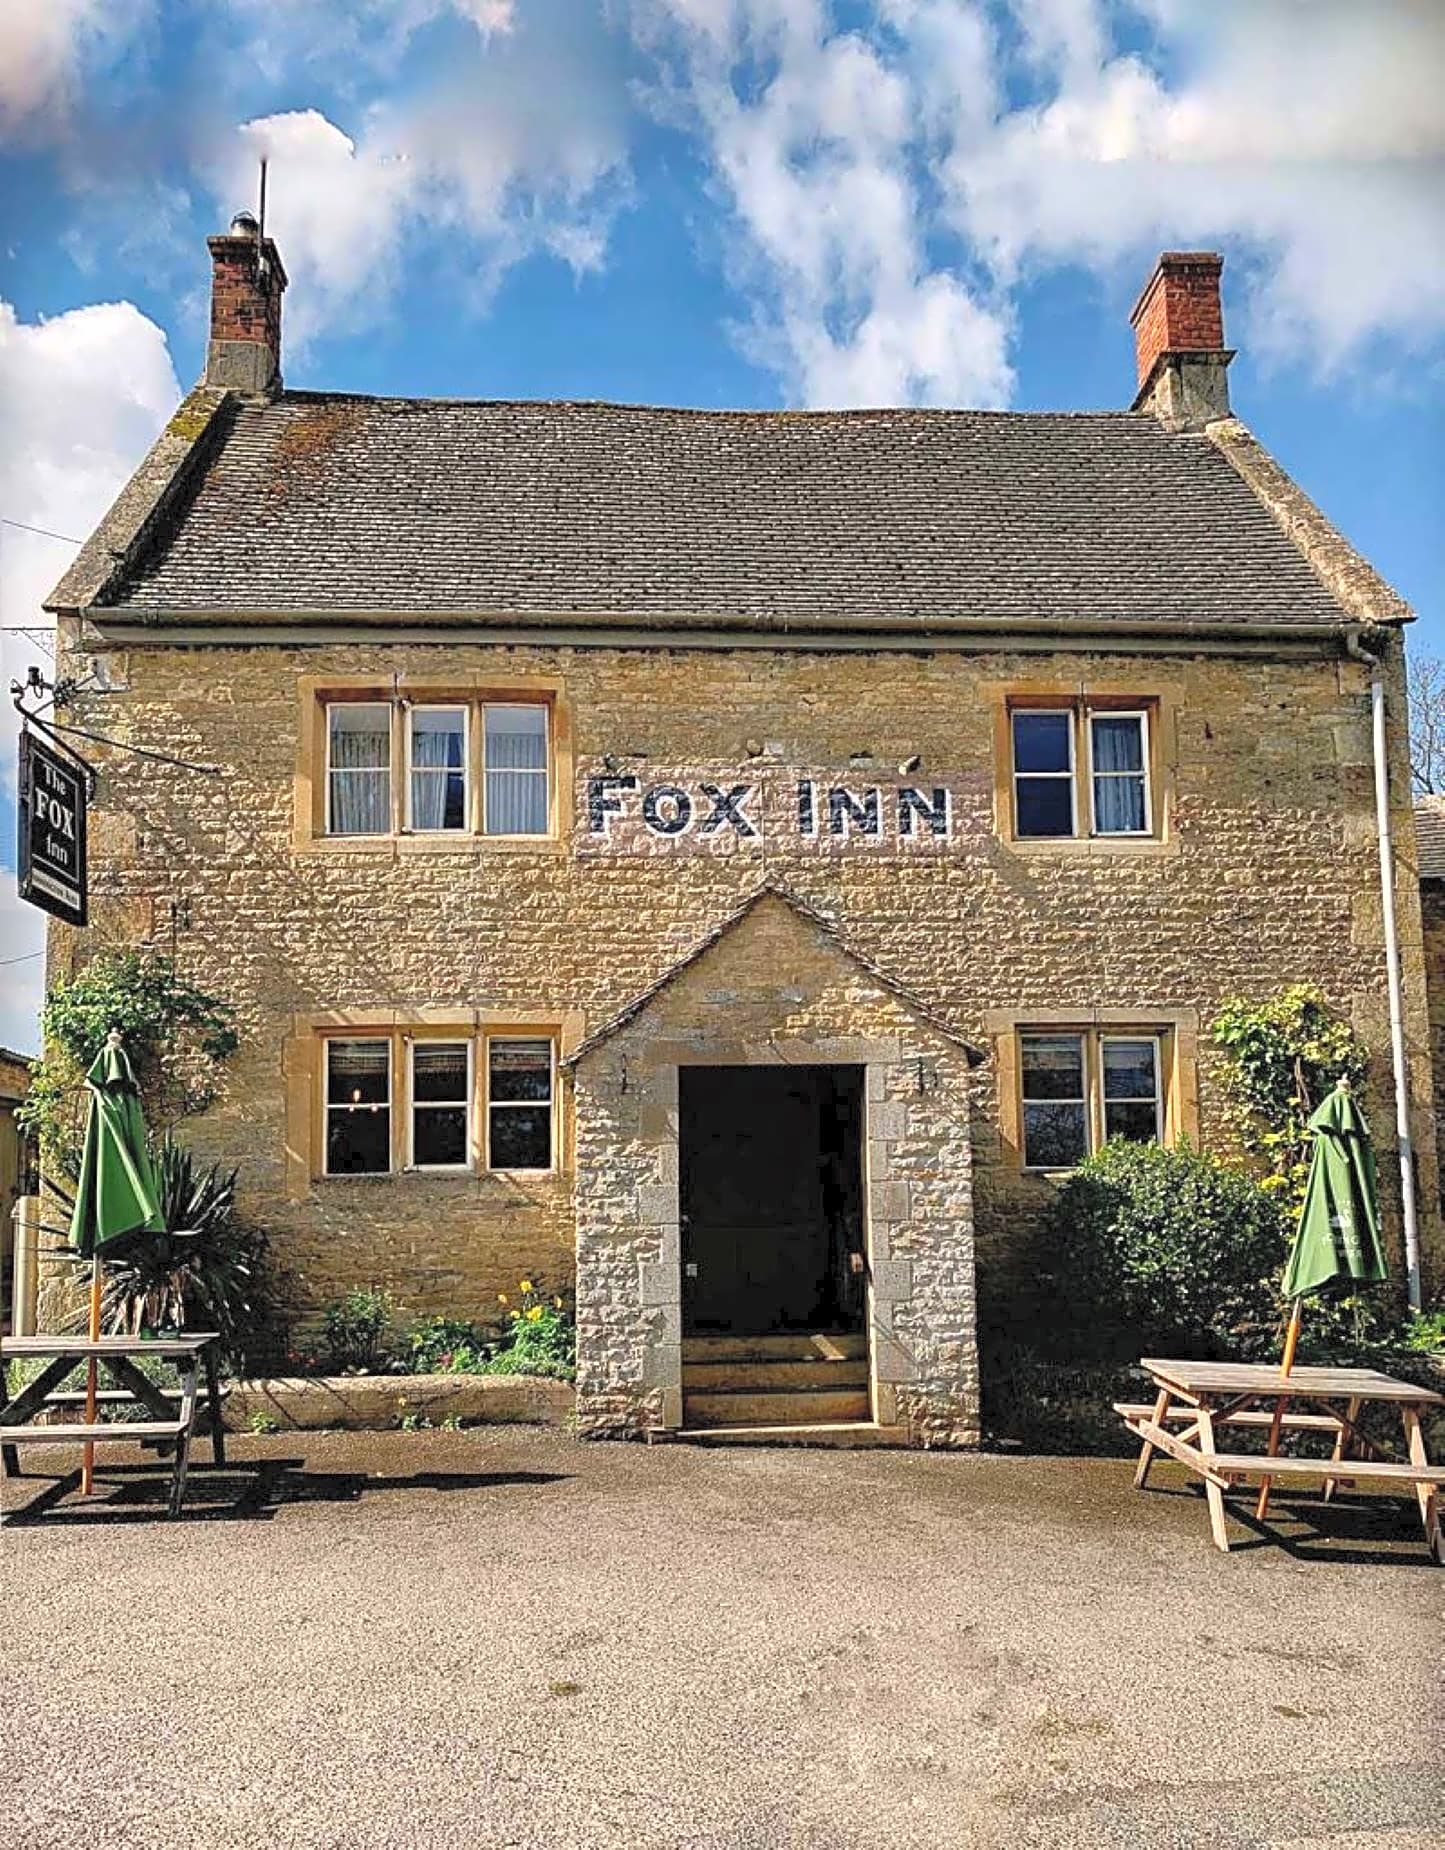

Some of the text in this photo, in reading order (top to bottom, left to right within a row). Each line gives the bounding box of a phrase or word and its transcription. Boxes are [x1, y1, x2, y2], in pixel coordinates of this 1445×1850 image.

[43, 763, 67, 795] The
[35, 786, 75, 840] FOX
[587, 775, 952, 840] FOX INN
